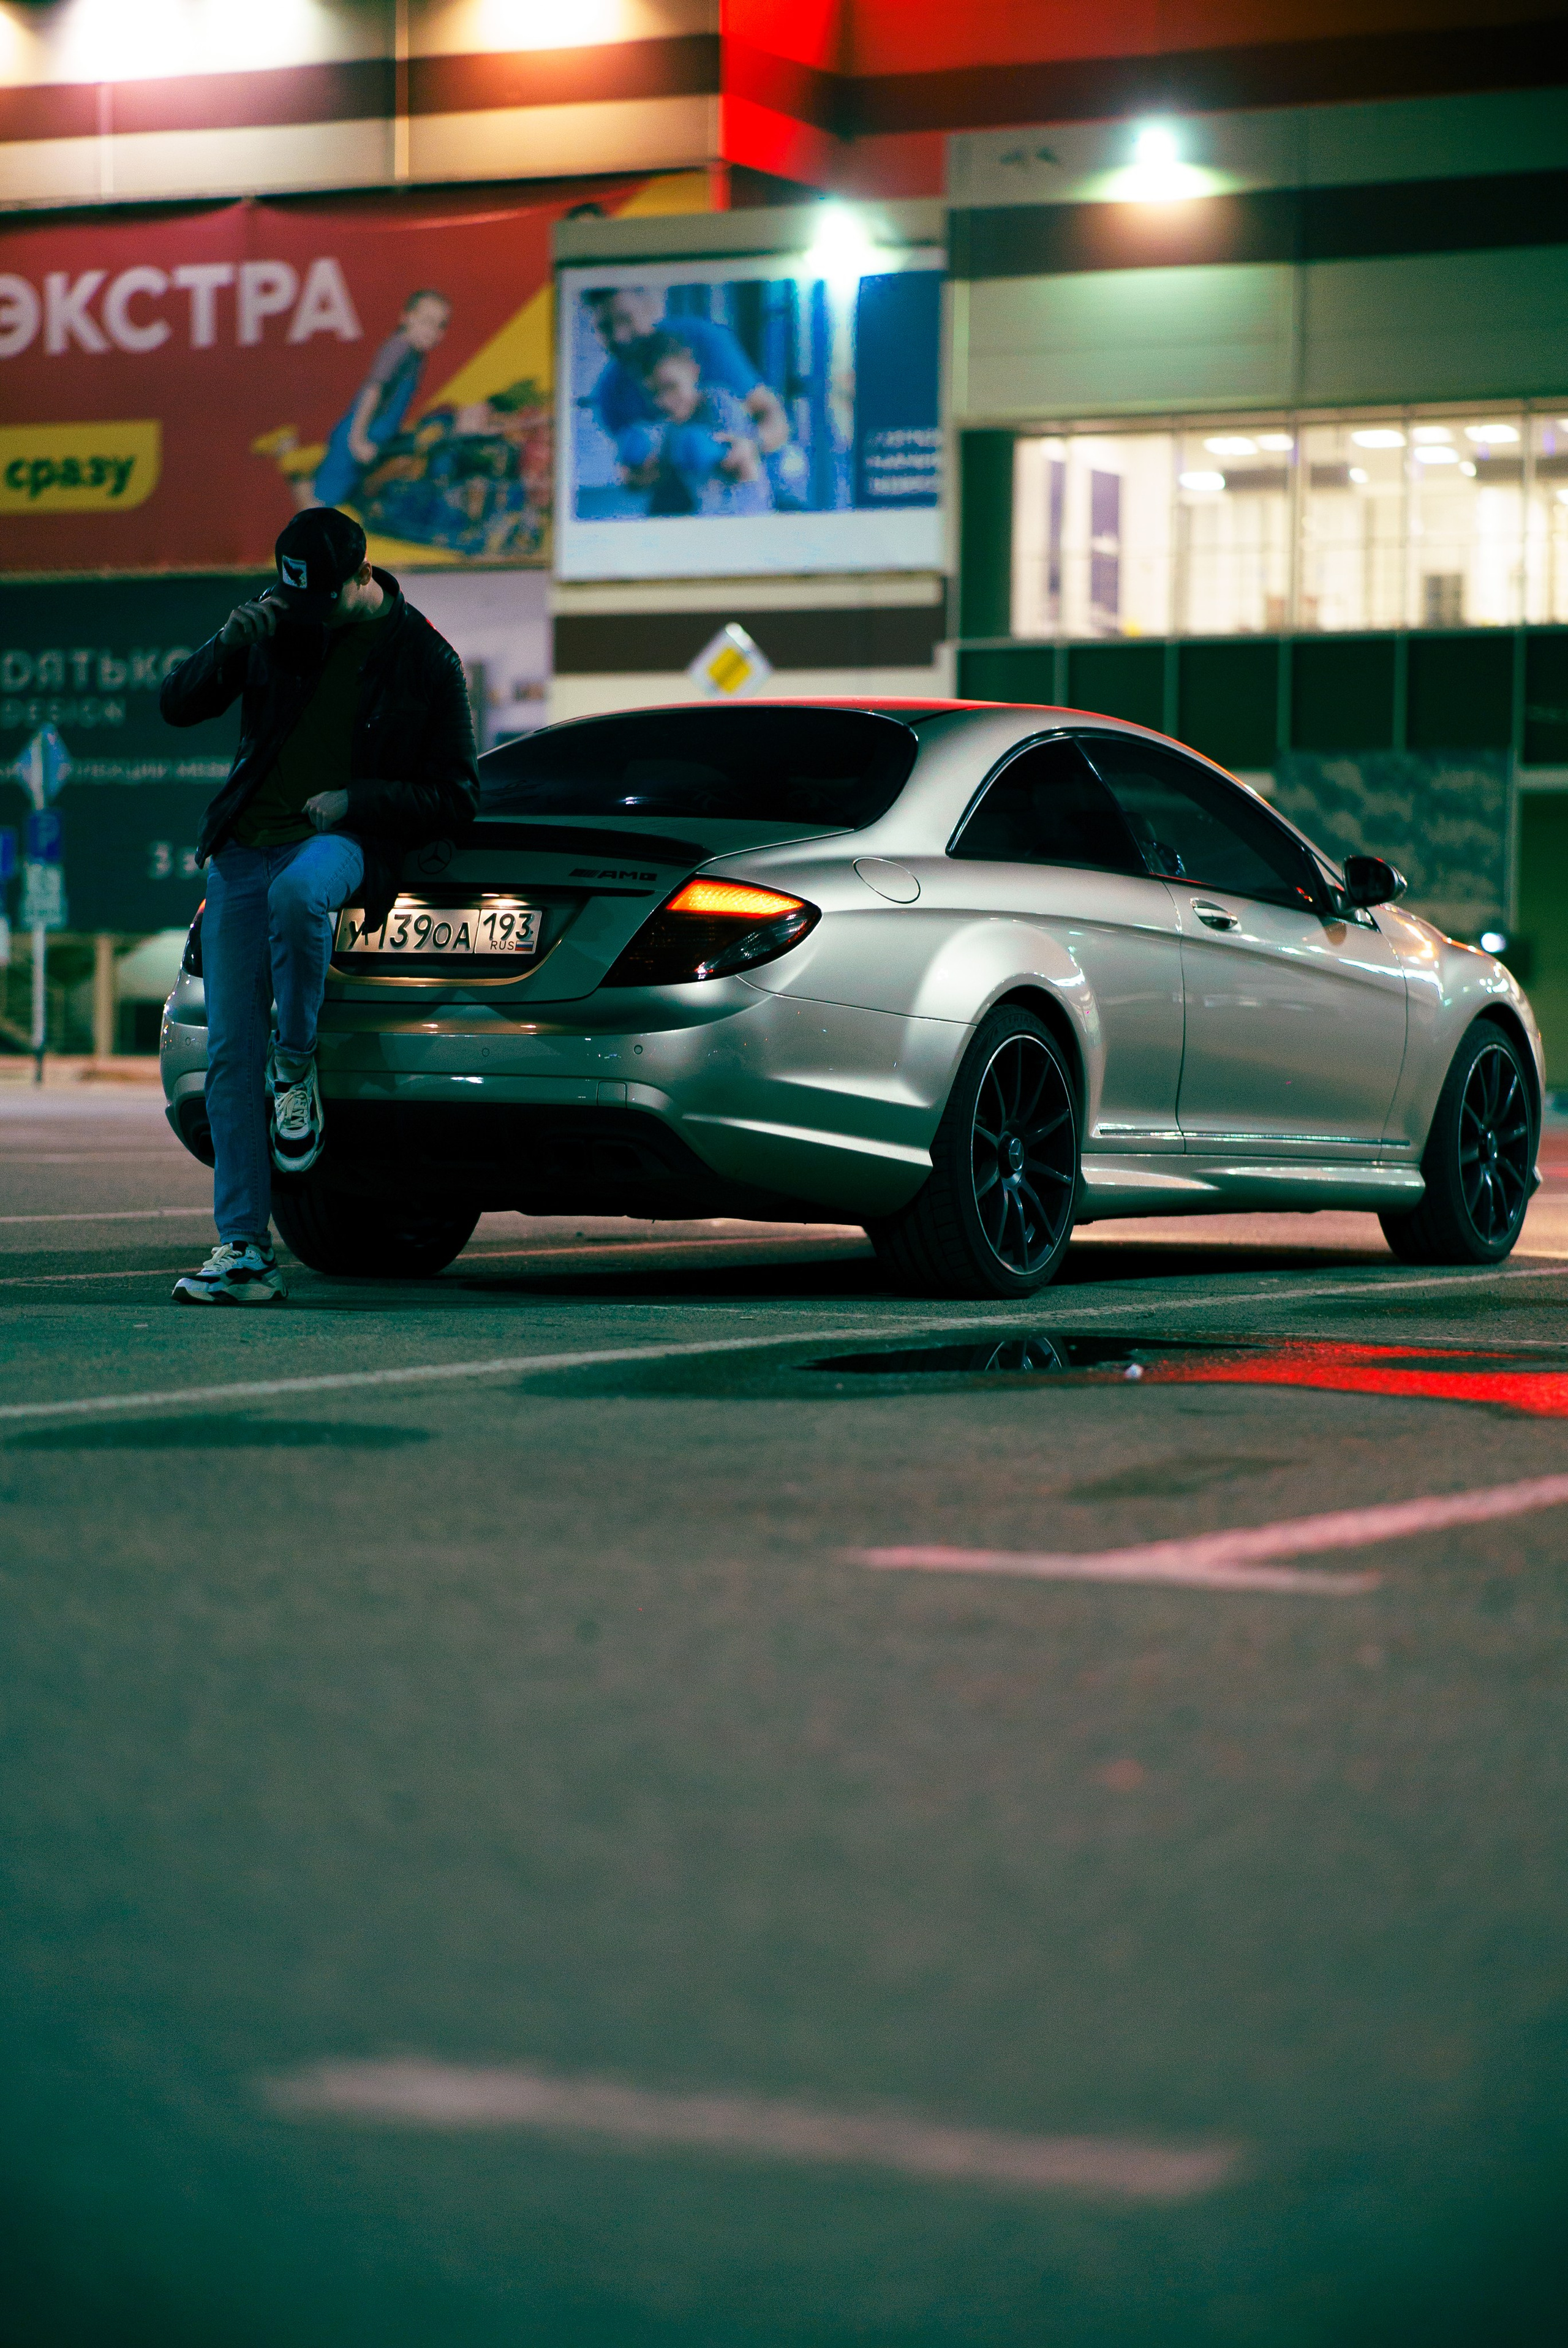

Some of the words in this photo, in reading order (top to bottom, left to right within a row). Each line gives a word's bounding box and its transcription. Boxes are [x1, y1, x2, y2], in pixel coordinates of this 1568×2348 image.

[0, 257, 364, 358] ЭКСТРА
[5, 456, 135, 500] сразу
[597, 870, 657, 881] AMG
[483, 912, 534, 941] 193
[489, 940, 514, 951] RUS
